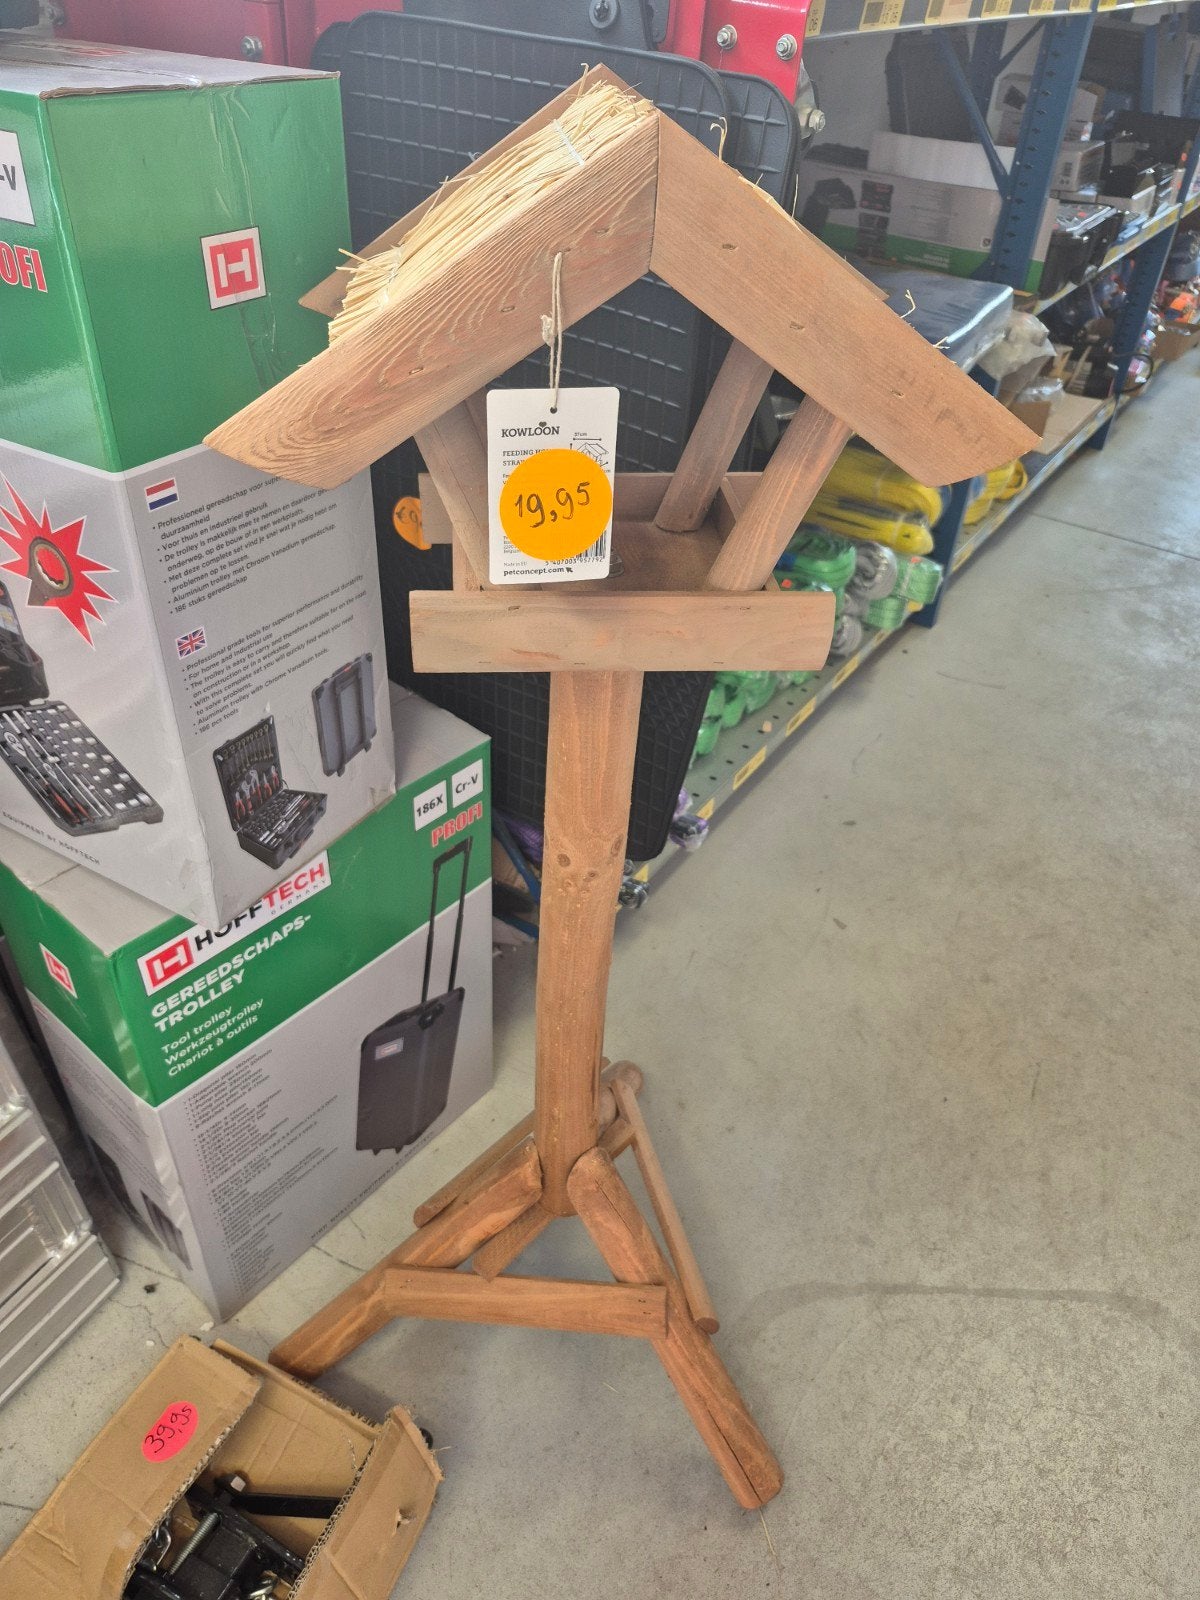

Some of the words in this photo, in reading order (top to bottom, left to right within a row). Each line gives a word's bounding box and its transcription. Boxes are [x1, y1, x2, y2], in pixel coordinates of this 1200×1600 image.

[501, 426, 560, 438] KOWLOON
[157, 504, 204, 529] Professioneel
[205, 487, 247, 511] gereedschap
[249, 482, 263, 492] voor
[160, 514, 210, 540] duurzaamheid
[162, 537, 179, 550] Voor
[181, 530, 198, 542] thuis
[209, 511, 243, 530] industrieel
[244, 501, 268, 517] gebruik
[514, 482, 590, 528] 19,95
[164, 551, 174, 561] De
[176, 541, 198, 558] trolley
[206, 525, 237, 544] makkelijk
[238, 520, 252, 530] mee
[261, 507, 281, 520] nemen
[167, 550, 204, 573] onderweg,
[205, 547, 214, 556] op
[215, 541, 224, 550] de
[225, 533, 242, 546] bouw
[244, 529, 251, 538] of
[259, 522, 270, 531] een
[168, 571, 182, 583] Met
[183, 563, 200, 576] deze
[201, 549, 232, 570] complete
[233, 544, 242, 554] set
[244, 538, 257, 549] vind
[258, 536, 264, 544] je
[266, 529, 277, 539] snel
[279, 523, 290, 533] wat
[297, 513, 314, 526] nodig
[171, 571, 208, 594] problemen
[209, 568, 218, 577] op
[219, 562, 226, 571] te
[172, 581, 209, 603] Aluminium
[210, 571, 230, 587] trolley
[232, 565, 244, 576] met
[246, 553, 270, 569] Chroom
[271, 539, 299, 557] Vanadium
[188, 594, 205, 607] stuks
[207, 574, 247, 599] gereedschap
[504, 568, 564, 576] petconcept.com
[186, 646, 225, 671] Professional
[227, 636, 244, 651] grade
[188, 670, 199, 680] For
[201, 660, 219, 674] home
[220, 653, 232, 663] and
[233, 637, 261, 656] industrial
[190, 678, 202, 689] The
[204, 667, 224, 683] trolley
[232, 656, 246, 668] easy
[247, 651, 254, 659] to
[271, 636, 282, 646] and
[193, 690, 202, 698] on
[203, 667, 241, 692] construction
[194, 694, 209, 707] With
[211, 687, 222, 698] this
[223, 671, 252, 692] complete
[253, 665, 262, 675] set
[263, 660, 274, 670] you
[196, 708, 203, 716] to
[204, 698, 221, 711] solve
[416, 794, 443, 816] 186X
[456, 774, 478, 794] Cr-V
[432, 801, 482, 848] PROFI
[271, 879, 326, 915] GERMANY
[152, 915, 311, 1017] GEREEDSCHAPS-
[154, 969, 244, 1032] TROLLEY
[162, 1032, 190, 1054] Tool
[193, 1006, 232, 1034] trolley
[165, 998, 264, 1065] Werkzeugtrolley
[168, 1044, 214, 1076] Chariot
[226, 1015, 258, 1039] outils
[145, 1405, 192, 1453] 39,95
